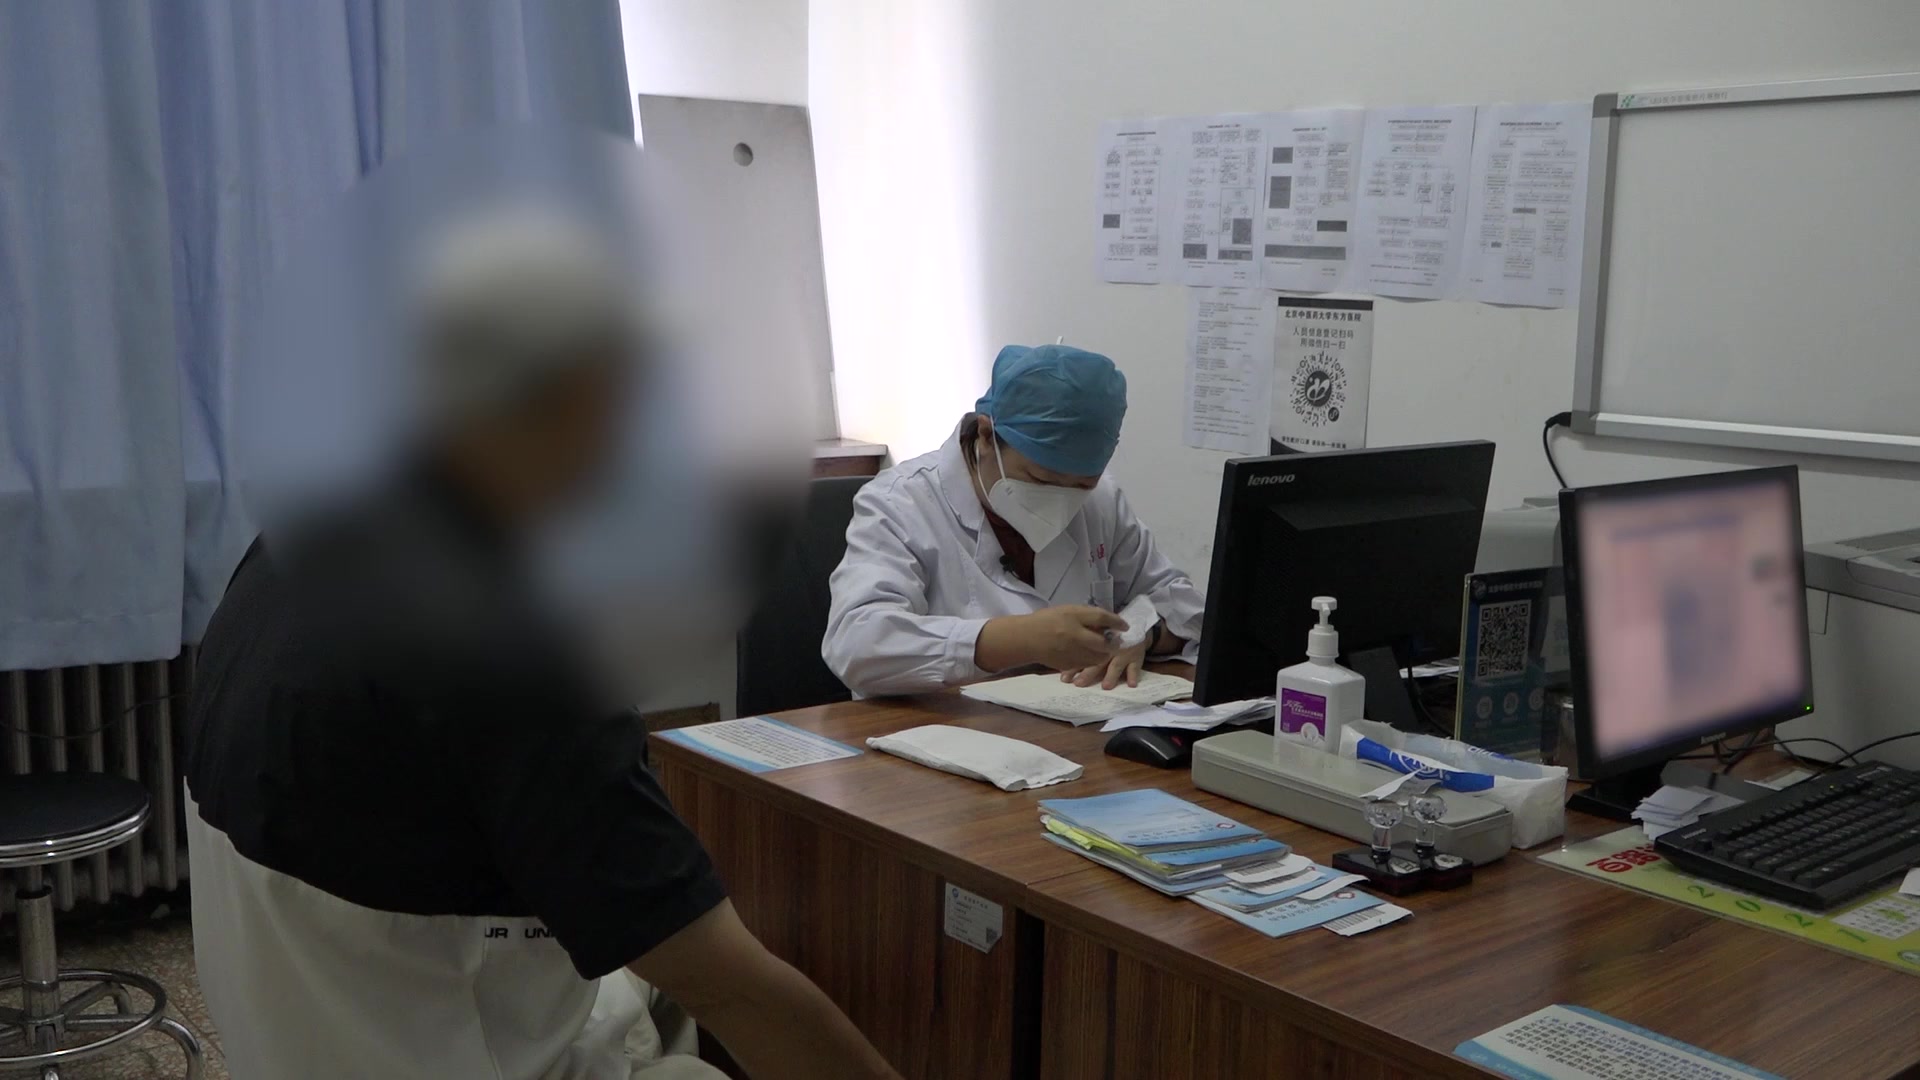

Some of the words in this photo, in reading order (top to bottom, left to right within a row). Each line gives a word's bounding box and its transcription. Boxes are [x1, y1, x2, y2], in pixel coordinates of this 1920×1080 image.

[1285, 309, 1362, 322] 北京中医药大学东方医院
[1247, 473, 1296, 487] lenovo
